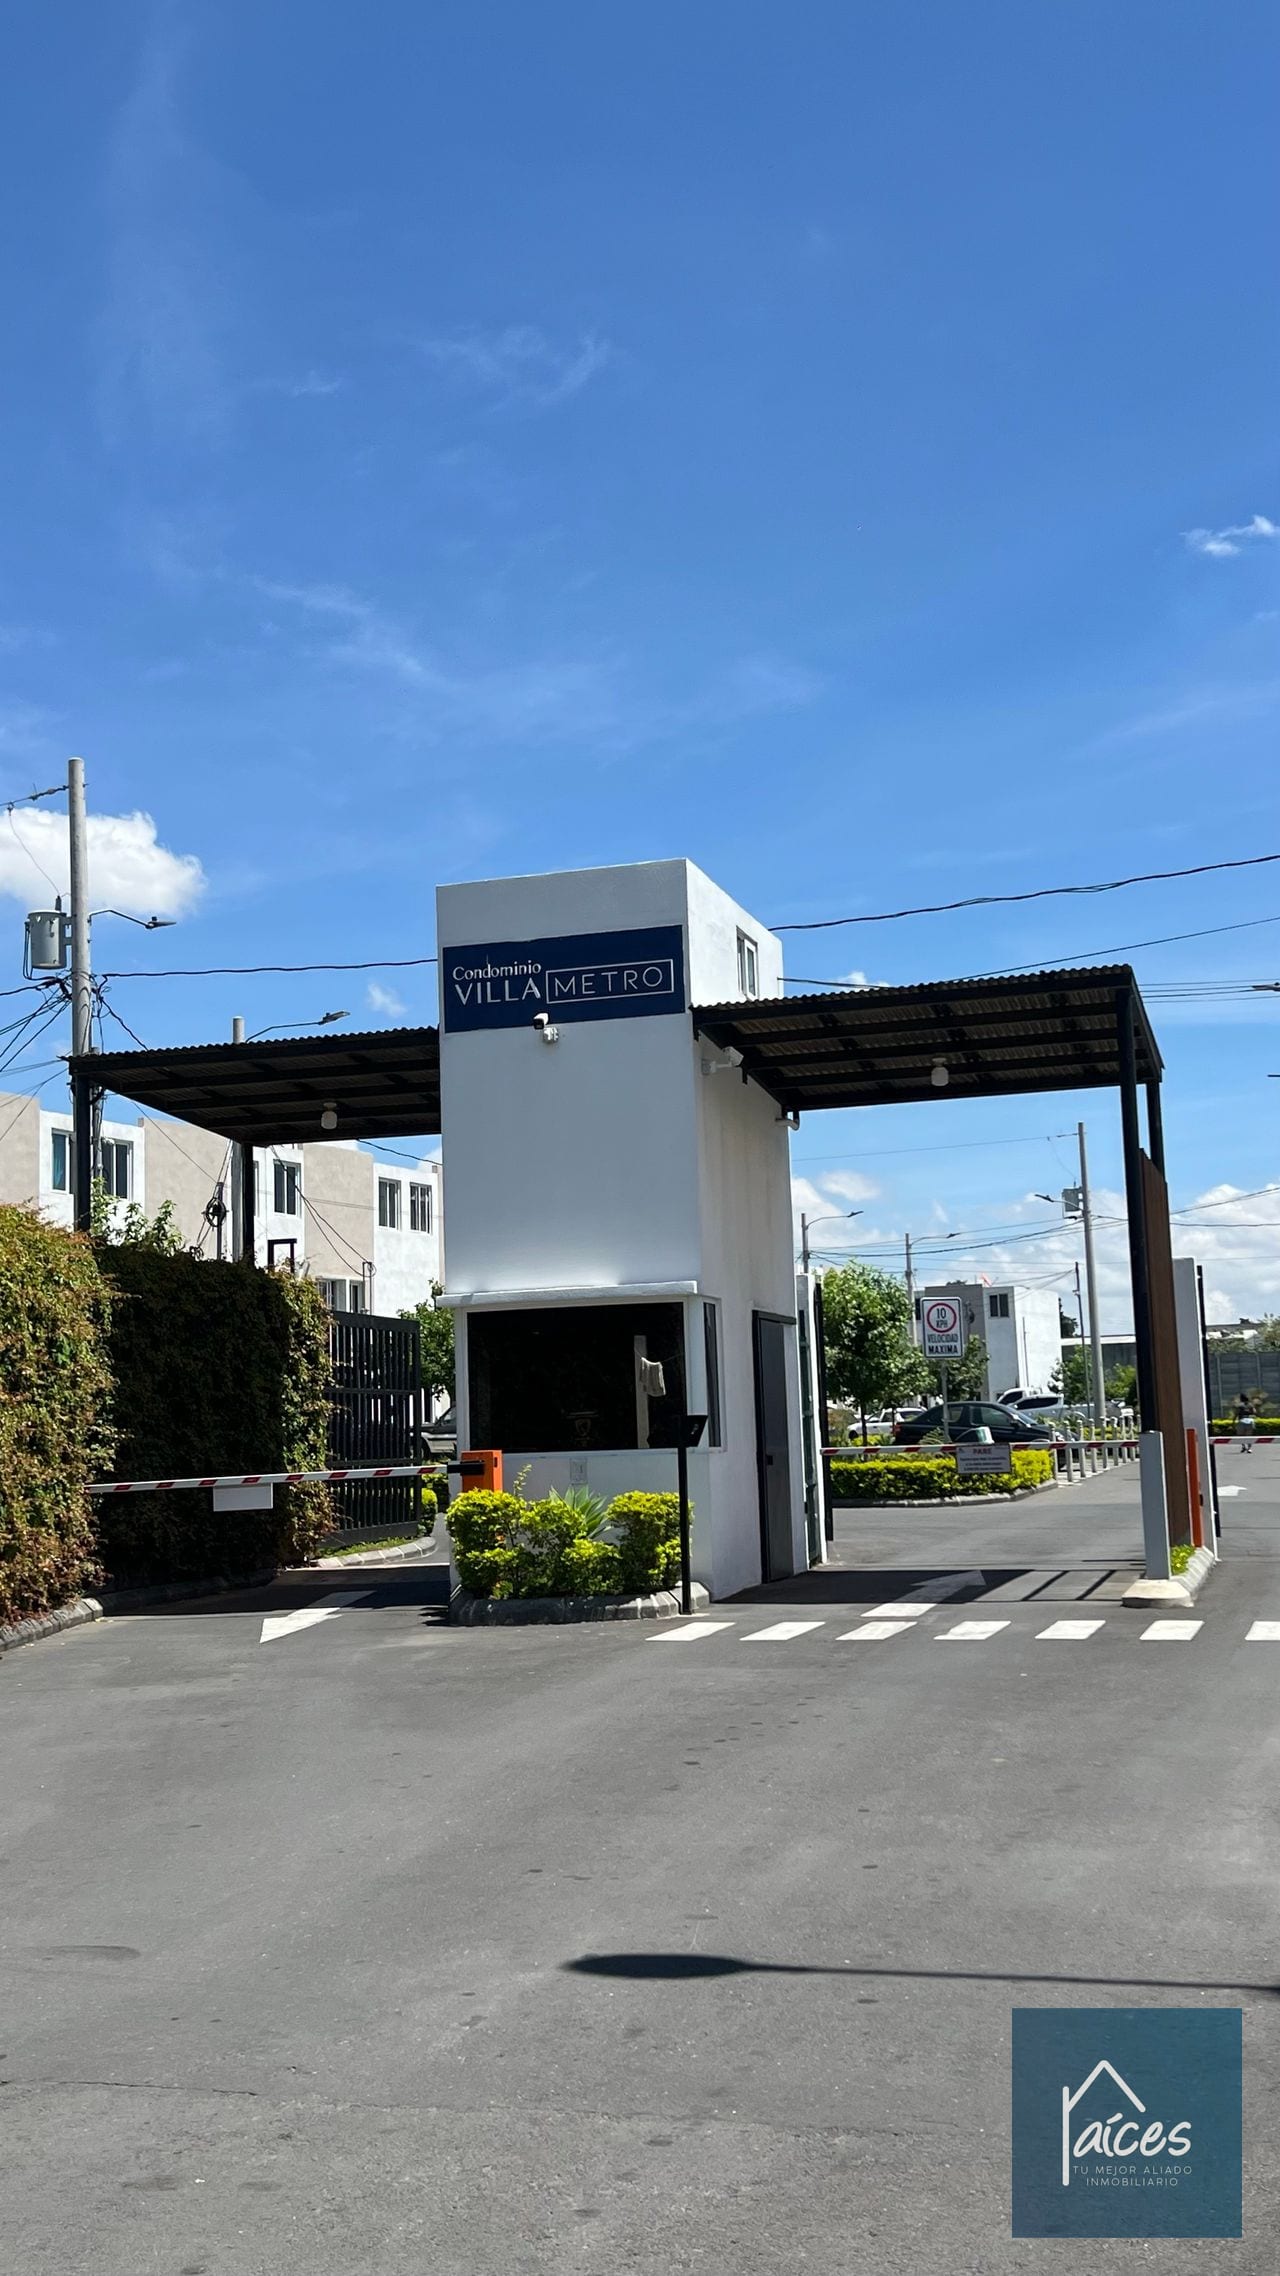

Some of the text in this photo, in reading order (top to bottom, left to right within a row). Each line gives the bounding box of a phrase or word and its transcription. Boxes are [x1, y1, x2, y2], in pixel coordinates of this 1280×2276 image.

[452, 960, 542, 981] Condominio
[455, 966, 663, 1006] VILLA METRO
[936, 1307, 947, 1319] 10
[927, 1334, 958, 1343] VELOCIDAD
[928, 1345, 958, 1354] MAXIMA
